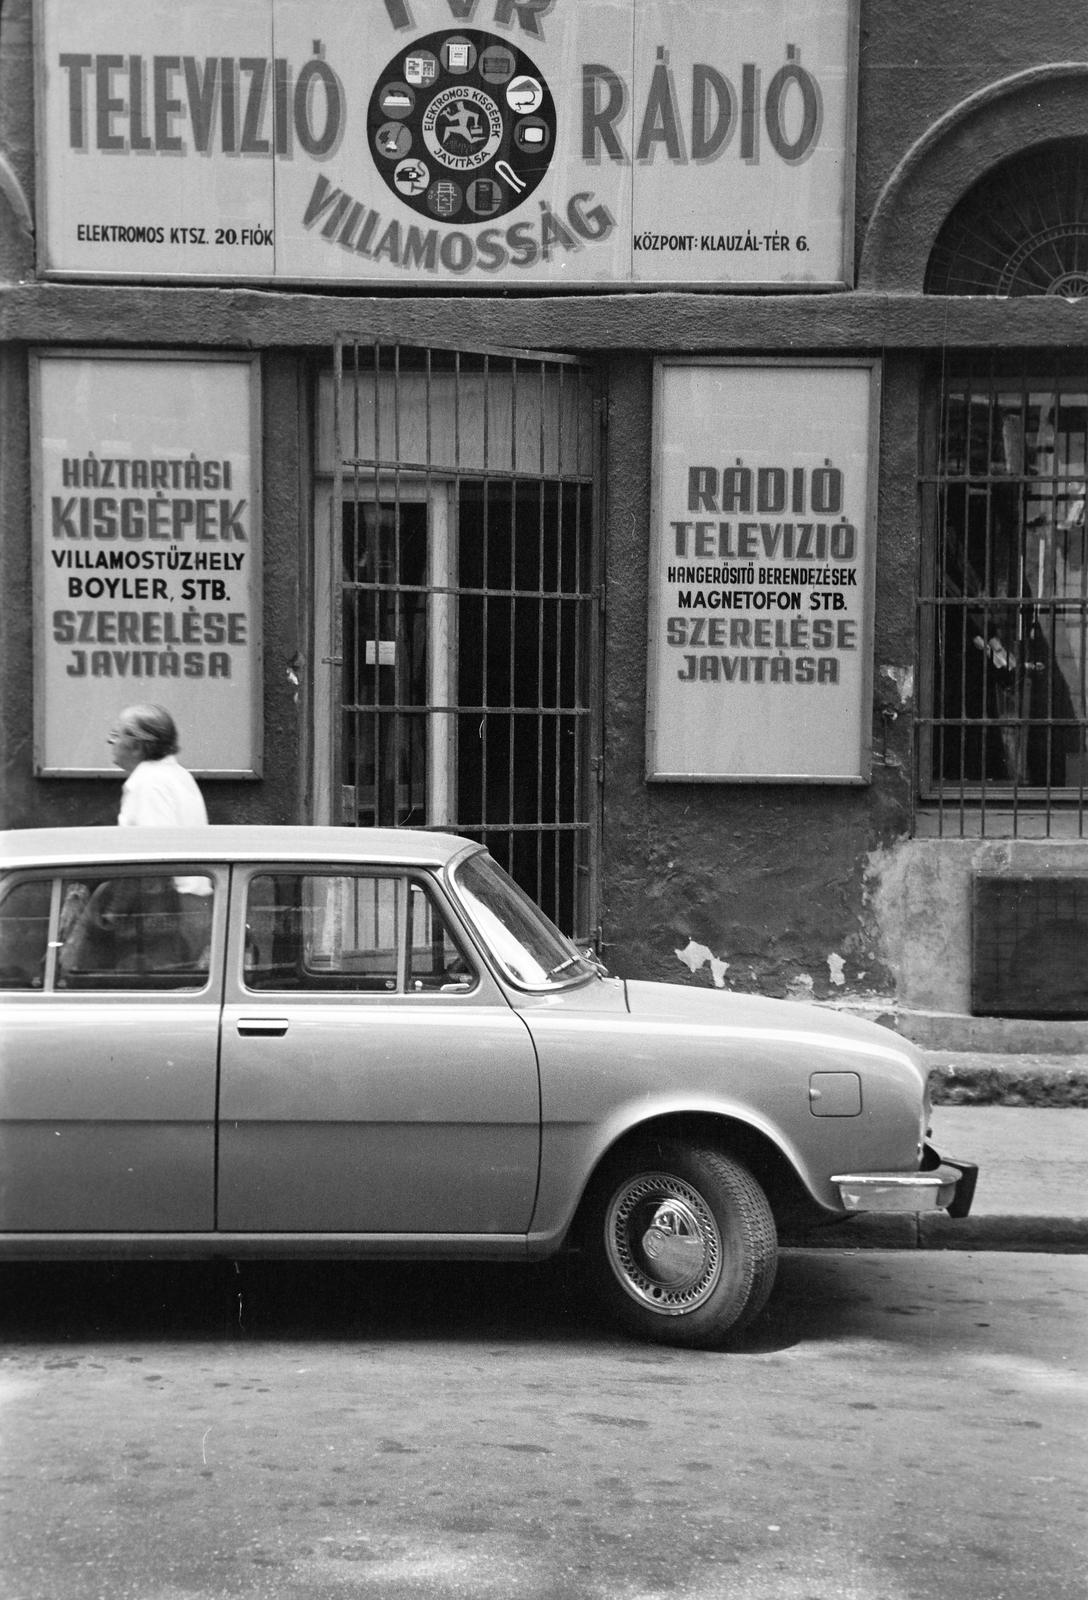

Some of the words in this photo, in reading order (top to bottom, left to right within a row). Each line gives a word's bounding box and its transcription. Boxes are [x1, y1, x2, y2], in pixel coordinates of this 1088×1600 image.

[59, 39, 346, 162] TELEVIZIÓ
[424, 88, 470, 131] ELEKTROMOS
[581, 43, 824, 166] RÁDIÓ
[77, 224, 165, 244] ELEKTROMOS
[170, 227, 209, 245] KTSZ.
[302, 172, 618, 274] VILLAMOSSÁG
[633, 231, 698, 251] KÖZPONT:
[700, 229, 790, 252] KLAUZÁL-TÉR
[796, 236, 810, 252] 6.
[62, 451, 233, 490] HÁZTARTÁSI
[687, 458, 844, 516] RÁDIÓ
[51, 491, 249, 542] KISGÉPEK
[670, 516, 857, 562] TELEVIZIÓ
[68, 577, 175, 603] BOYLER,
[181, 578, 231, 601] STB.
[758, 564, 857, 586] BERENDEZÉSEK
[678, 590, 802, 611] MAGNETOFON
[809, 592, 848, 611] STB.
[53, 605, 248, 645] SZERELÉSE
[667, 614, 858, 650] SZERELÉSE
[66, 645, 232, 679] JAVITÁSA
[677, 650, 840, 685] JAVITÁSA
